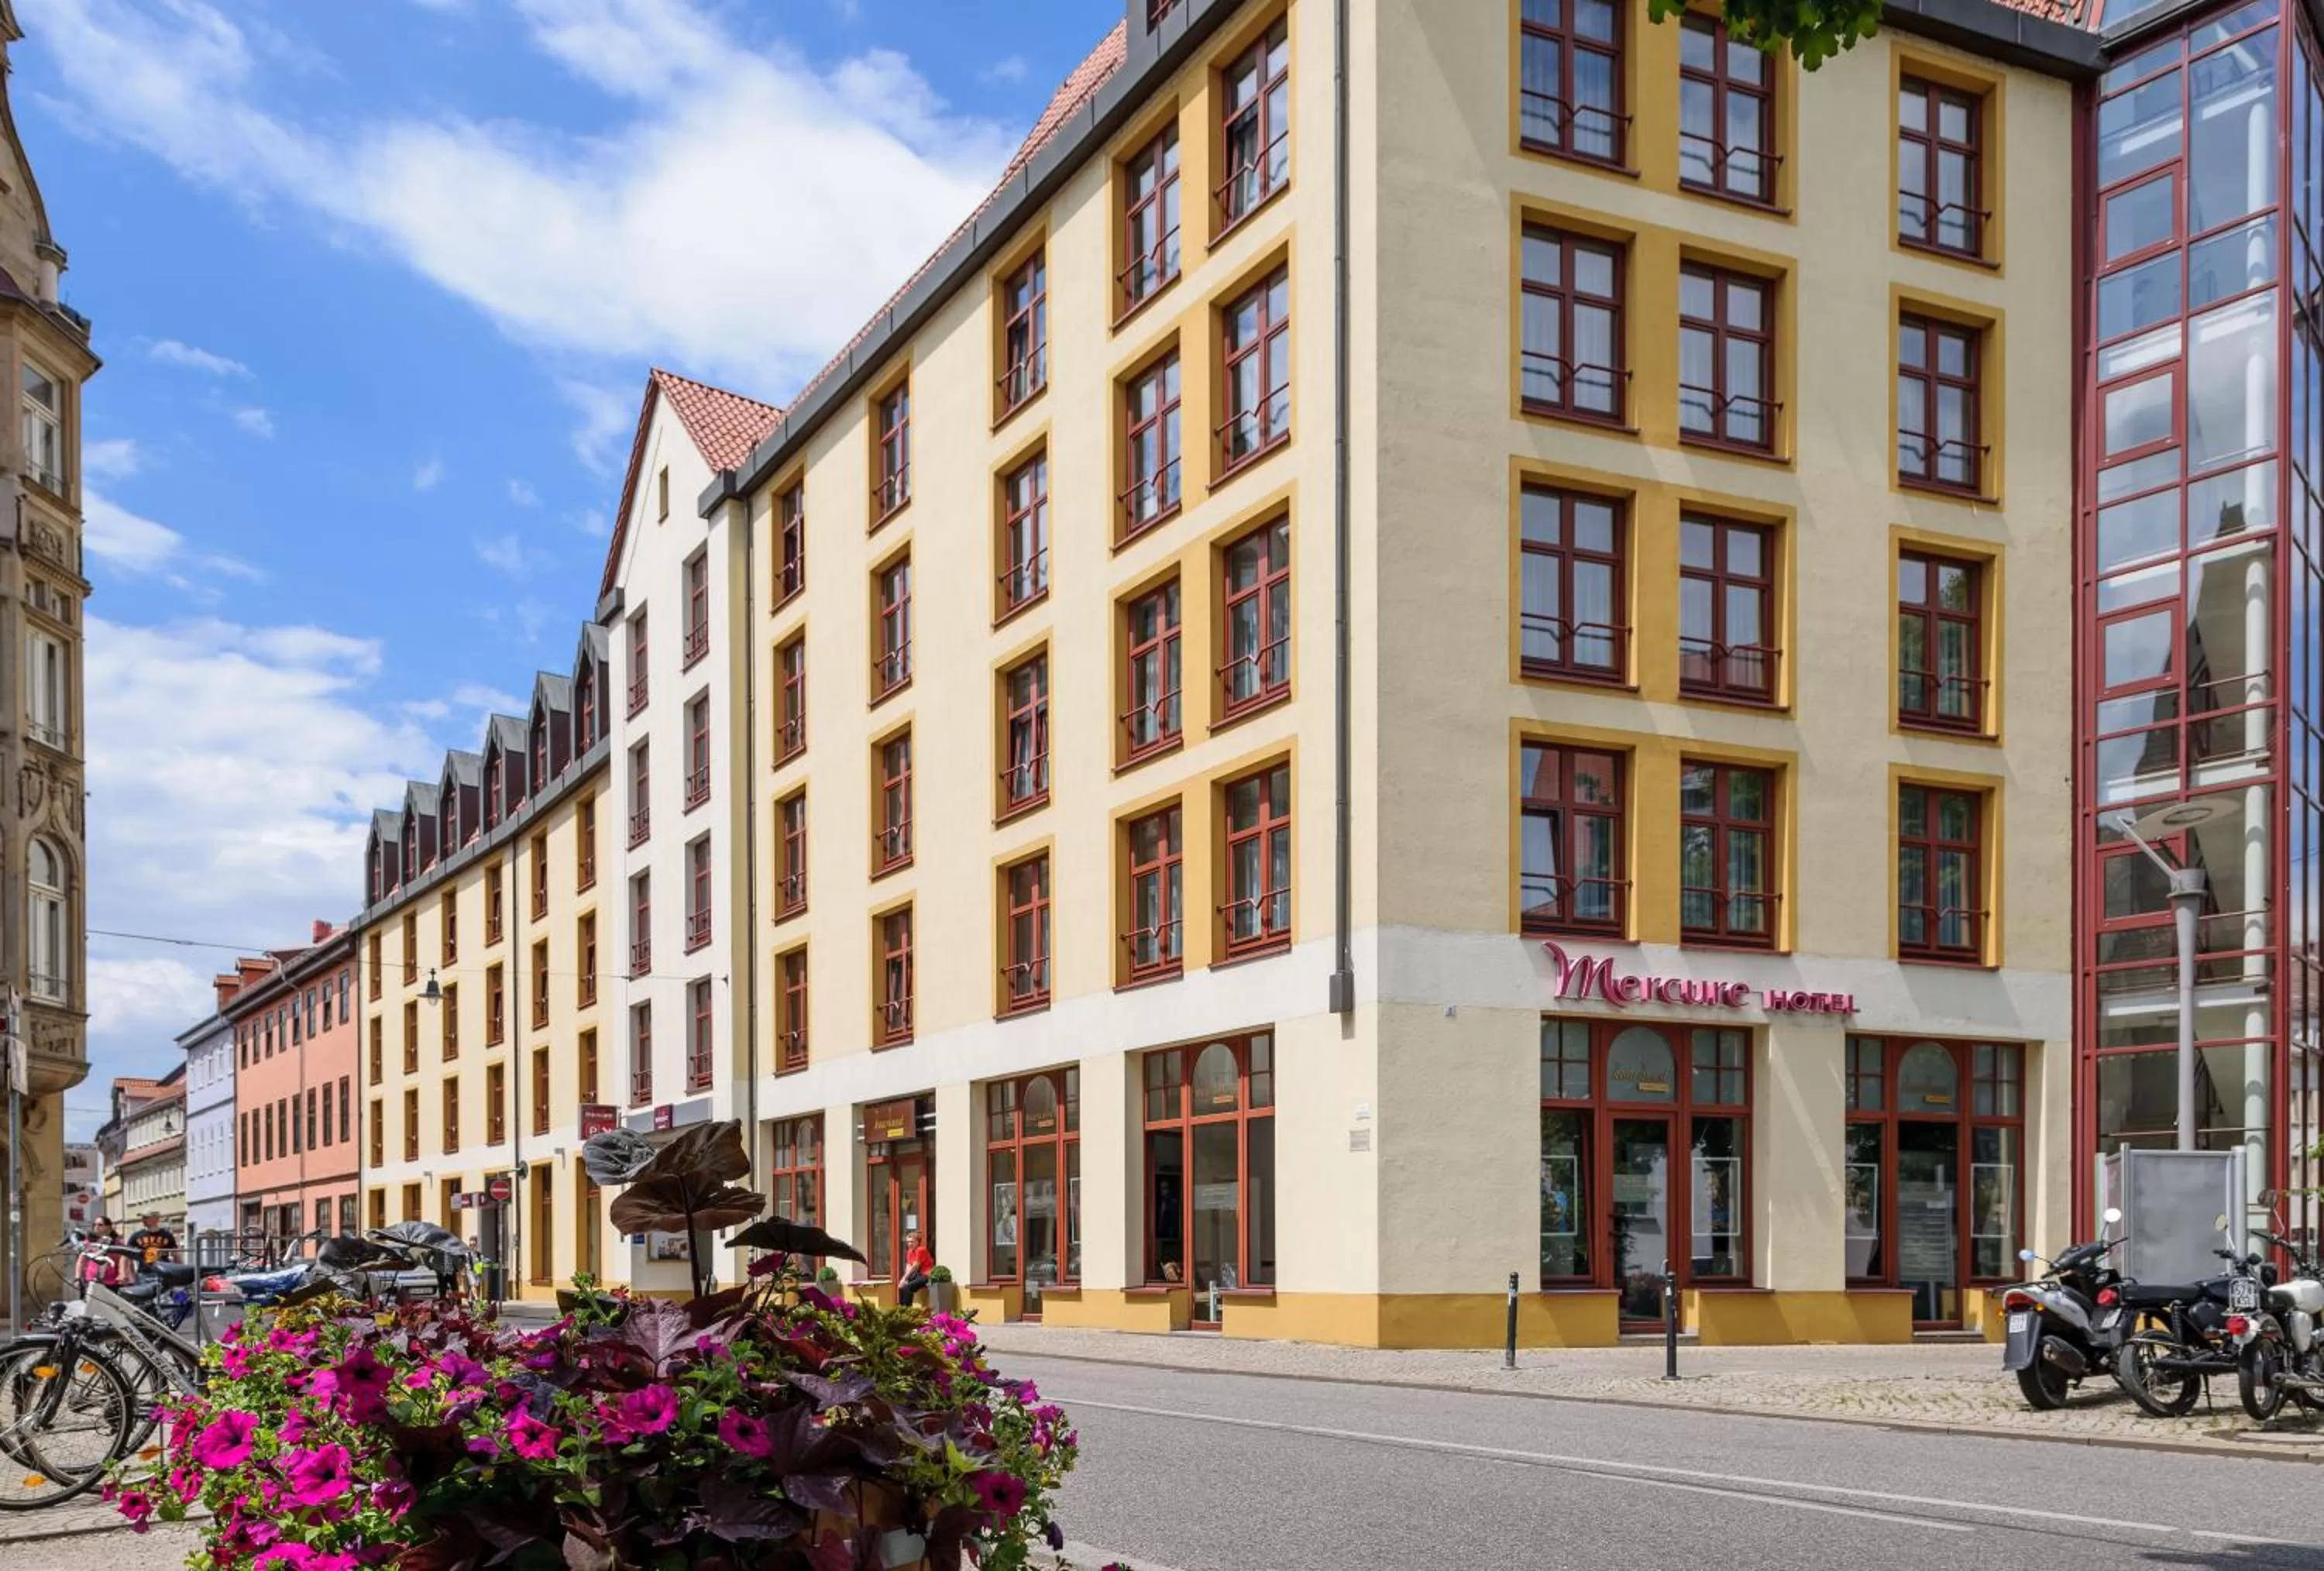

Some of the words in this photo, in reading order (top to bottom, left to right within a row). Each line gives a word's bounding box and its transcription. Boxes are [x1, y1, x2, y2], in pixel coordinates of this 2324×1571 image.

[1542, 941, 1751, 1007] Mercure
[1764, 989, 1859, 1012] HOTEL
[120, 1325, 177, 1381] PEGASUS
